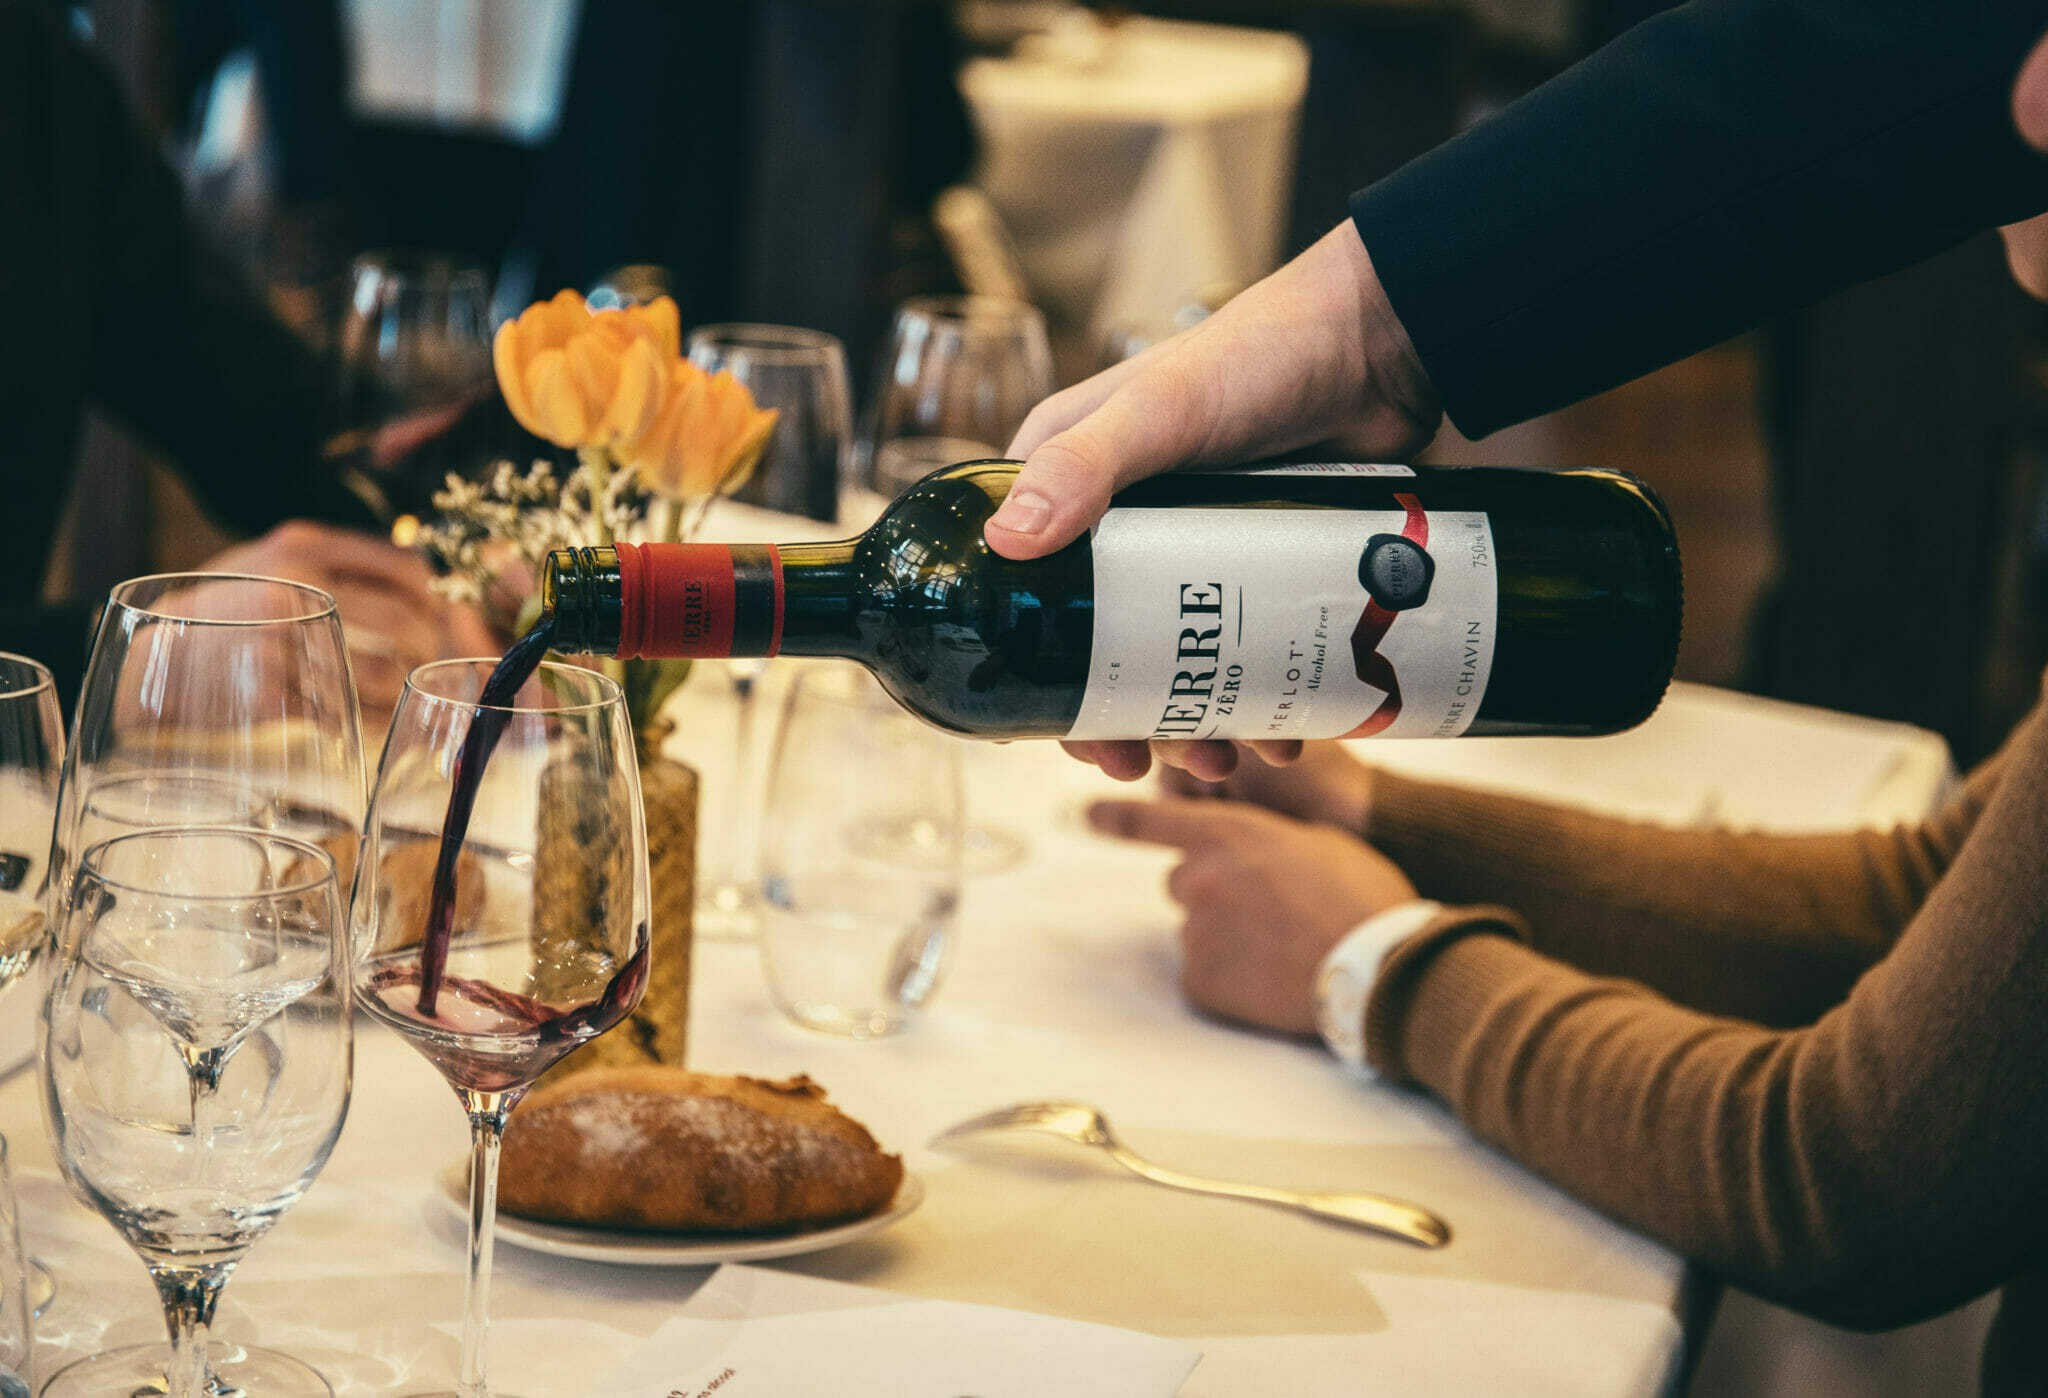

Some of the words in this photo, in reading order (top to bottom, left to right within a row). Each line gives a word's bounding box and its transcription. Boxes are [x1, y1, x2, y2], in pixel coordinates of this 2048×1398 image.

[1315, 606, 1328, 639] Free
[1307, 644, 1326, 691] Alcohol
[1456, 621, 1481, 696] CHAVIN
